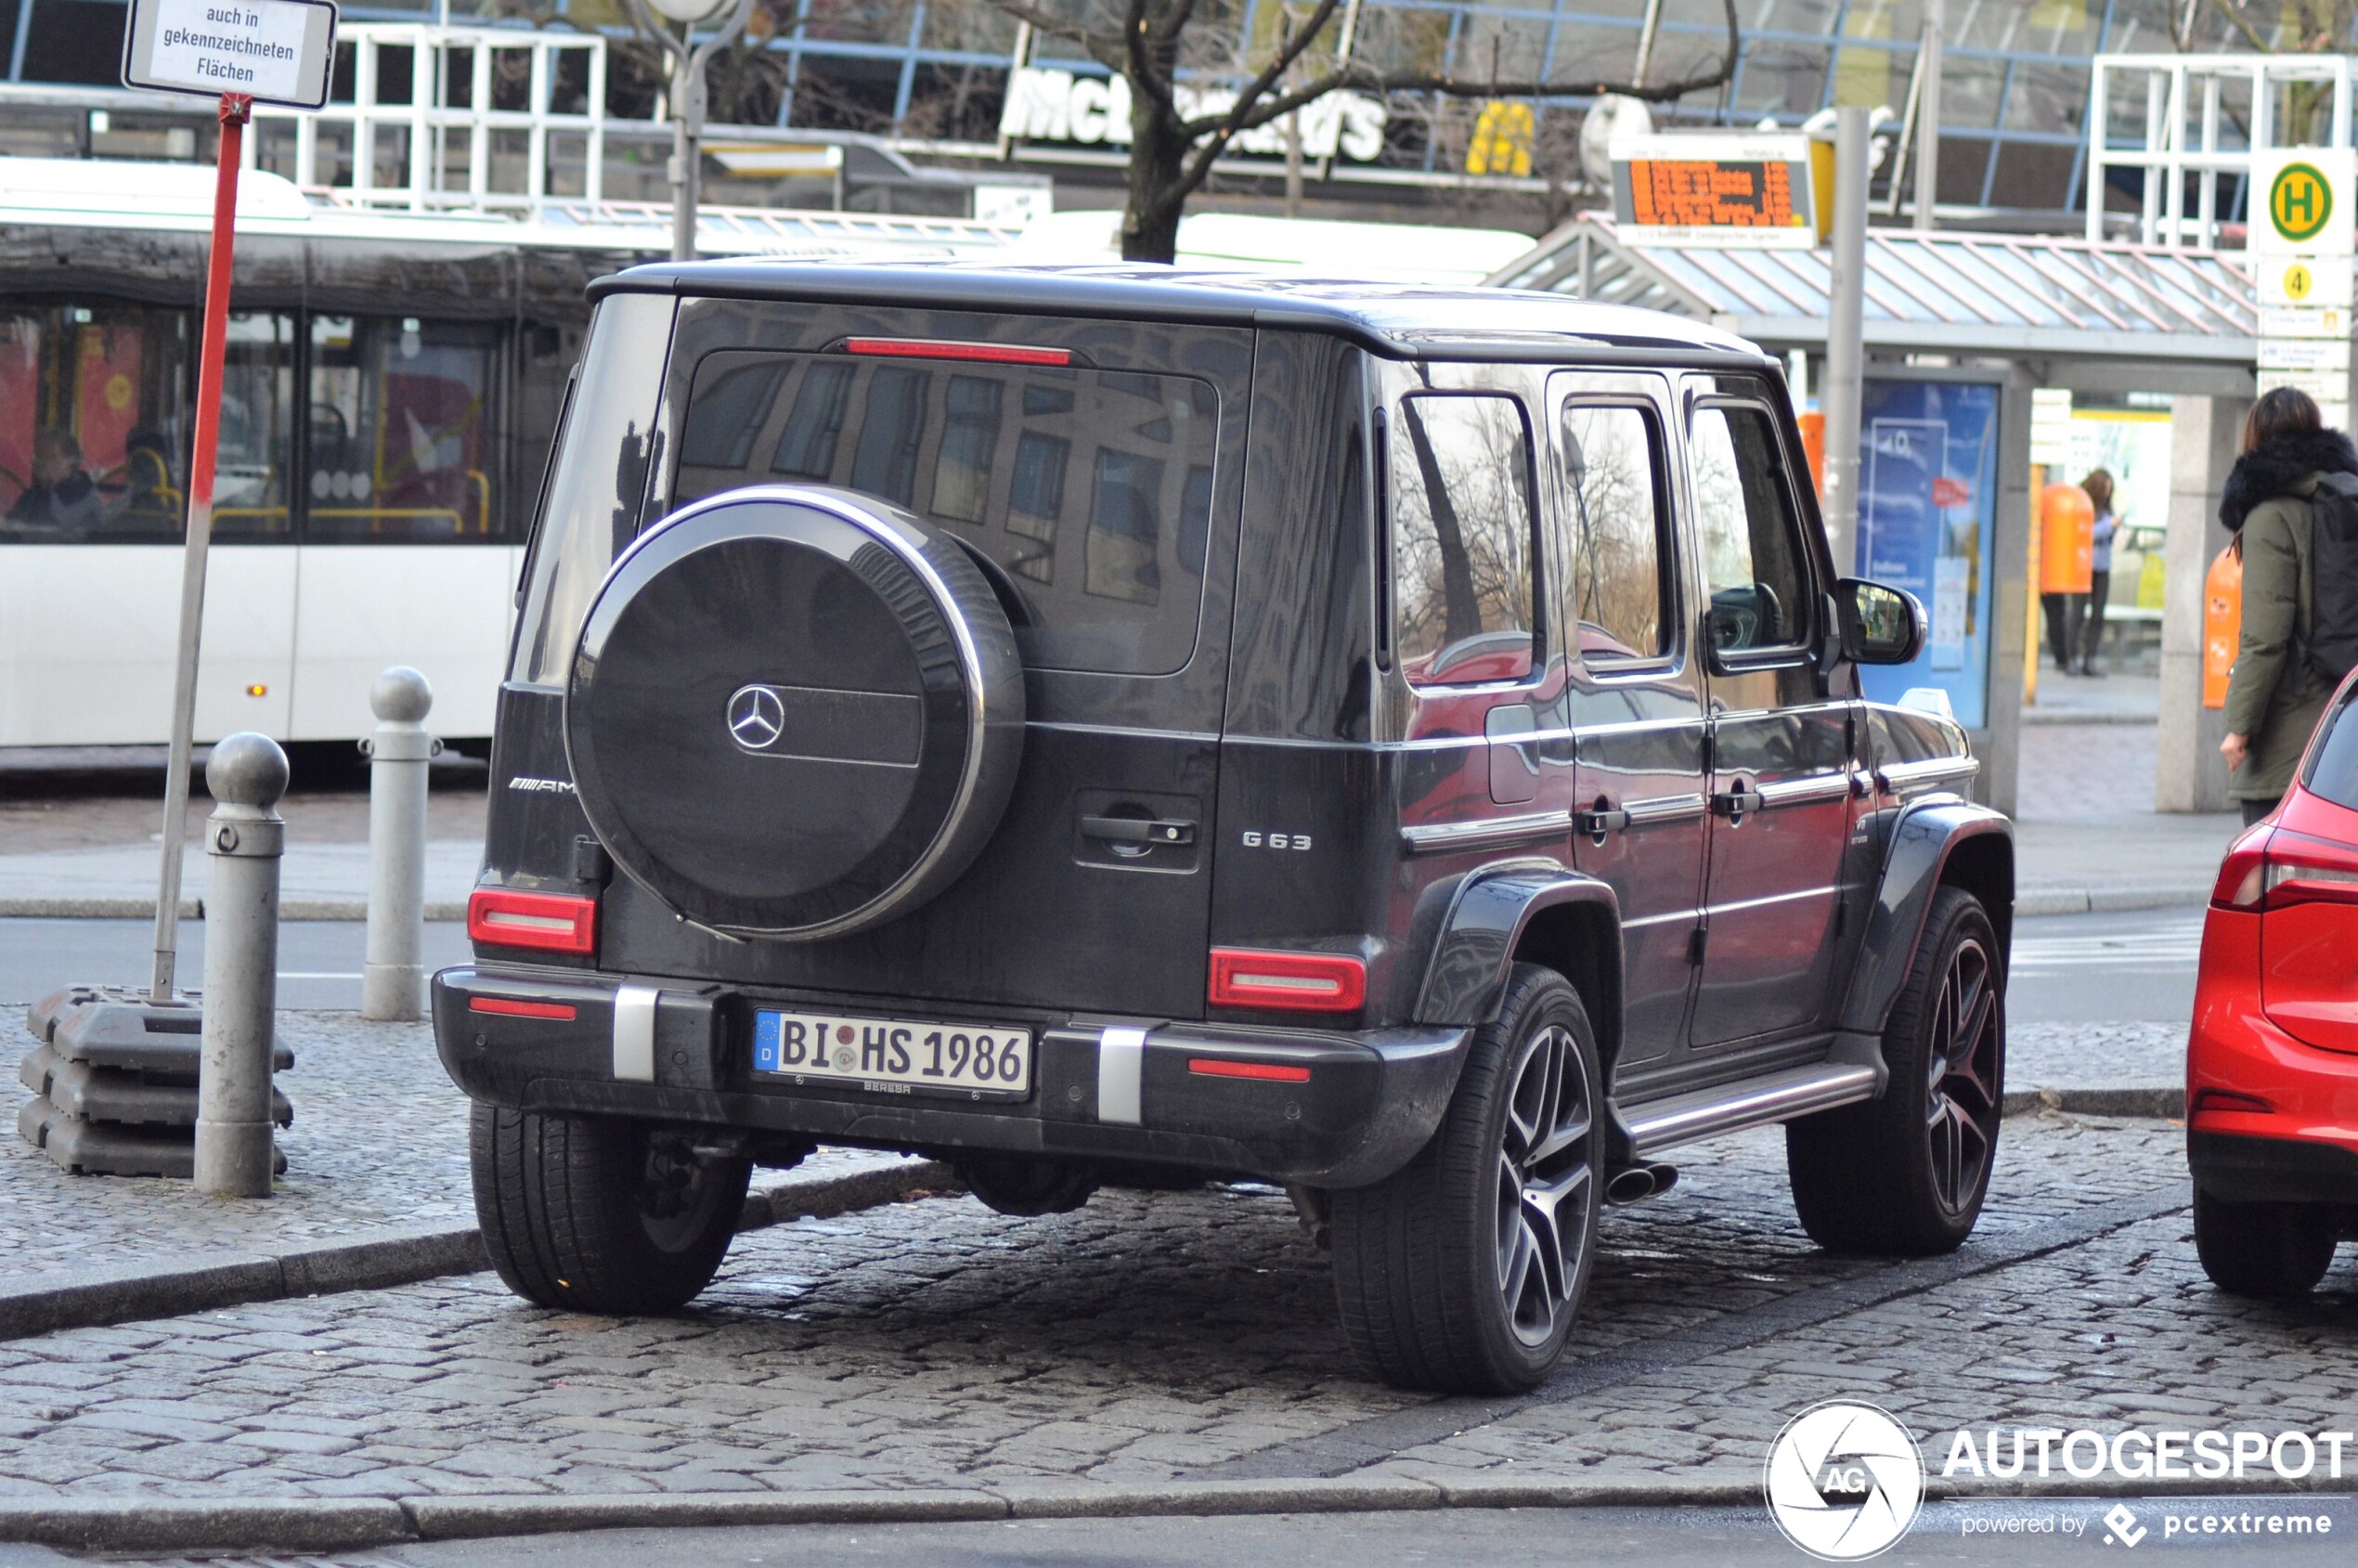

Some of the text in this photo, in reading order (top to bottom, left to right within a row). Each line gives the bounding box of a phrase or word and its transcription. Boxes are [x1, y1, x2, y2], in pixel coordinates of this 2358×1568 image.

[207, 7, 259, 27] auch in
[163, 28, 293, 60] gekennzeichneten
[197, 58, 253, 82] Flächen
[2285, 182, 2313, 223] H
[2291, 271, 2302, 292] 4
[535, 779, 577, 794] AM
[1242, 831, 1312, 851] G 63
[760, 1047, 771, 1061] D
[783, 1019, 1022, 1083] BI HS 1986
[863, 1082, 912, 1095] BERESA
